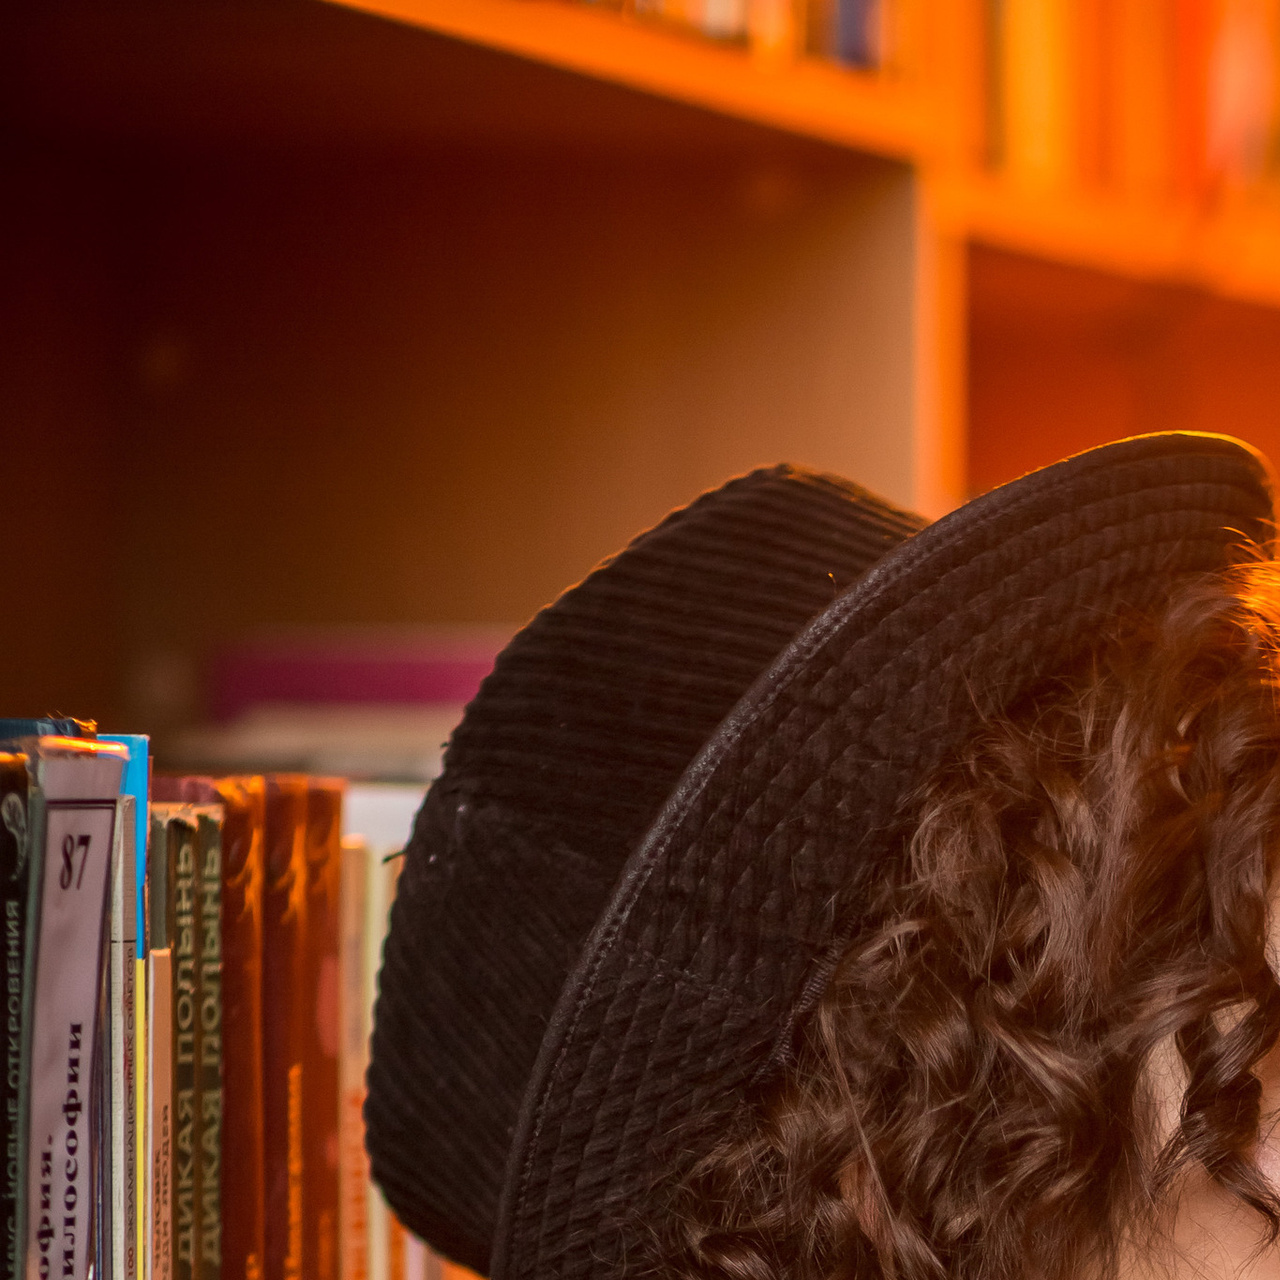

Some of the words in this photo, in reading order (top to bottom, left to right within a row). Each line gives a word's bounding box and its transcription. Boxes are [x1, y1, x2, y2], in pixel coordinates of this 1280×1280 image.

[60, 834, 91, 890] 87
[6, 900, 20, 1089] ОТКРОВЕНИЯ
[125, 947, 134, 1031] ОТВЕТОВ
[176, 844, 194, 1064] ПОЛЫНЬ
[201, 847, 220, 1067] ПОЛЫНЬ
[126, 1036, 134, 1241] ЭКЗАМЕНАЦИОННЫХ
[176, 1090, 194, 1261] ДИКАЯ
[201, 1088, 221, 1265] ДИКАЯ
